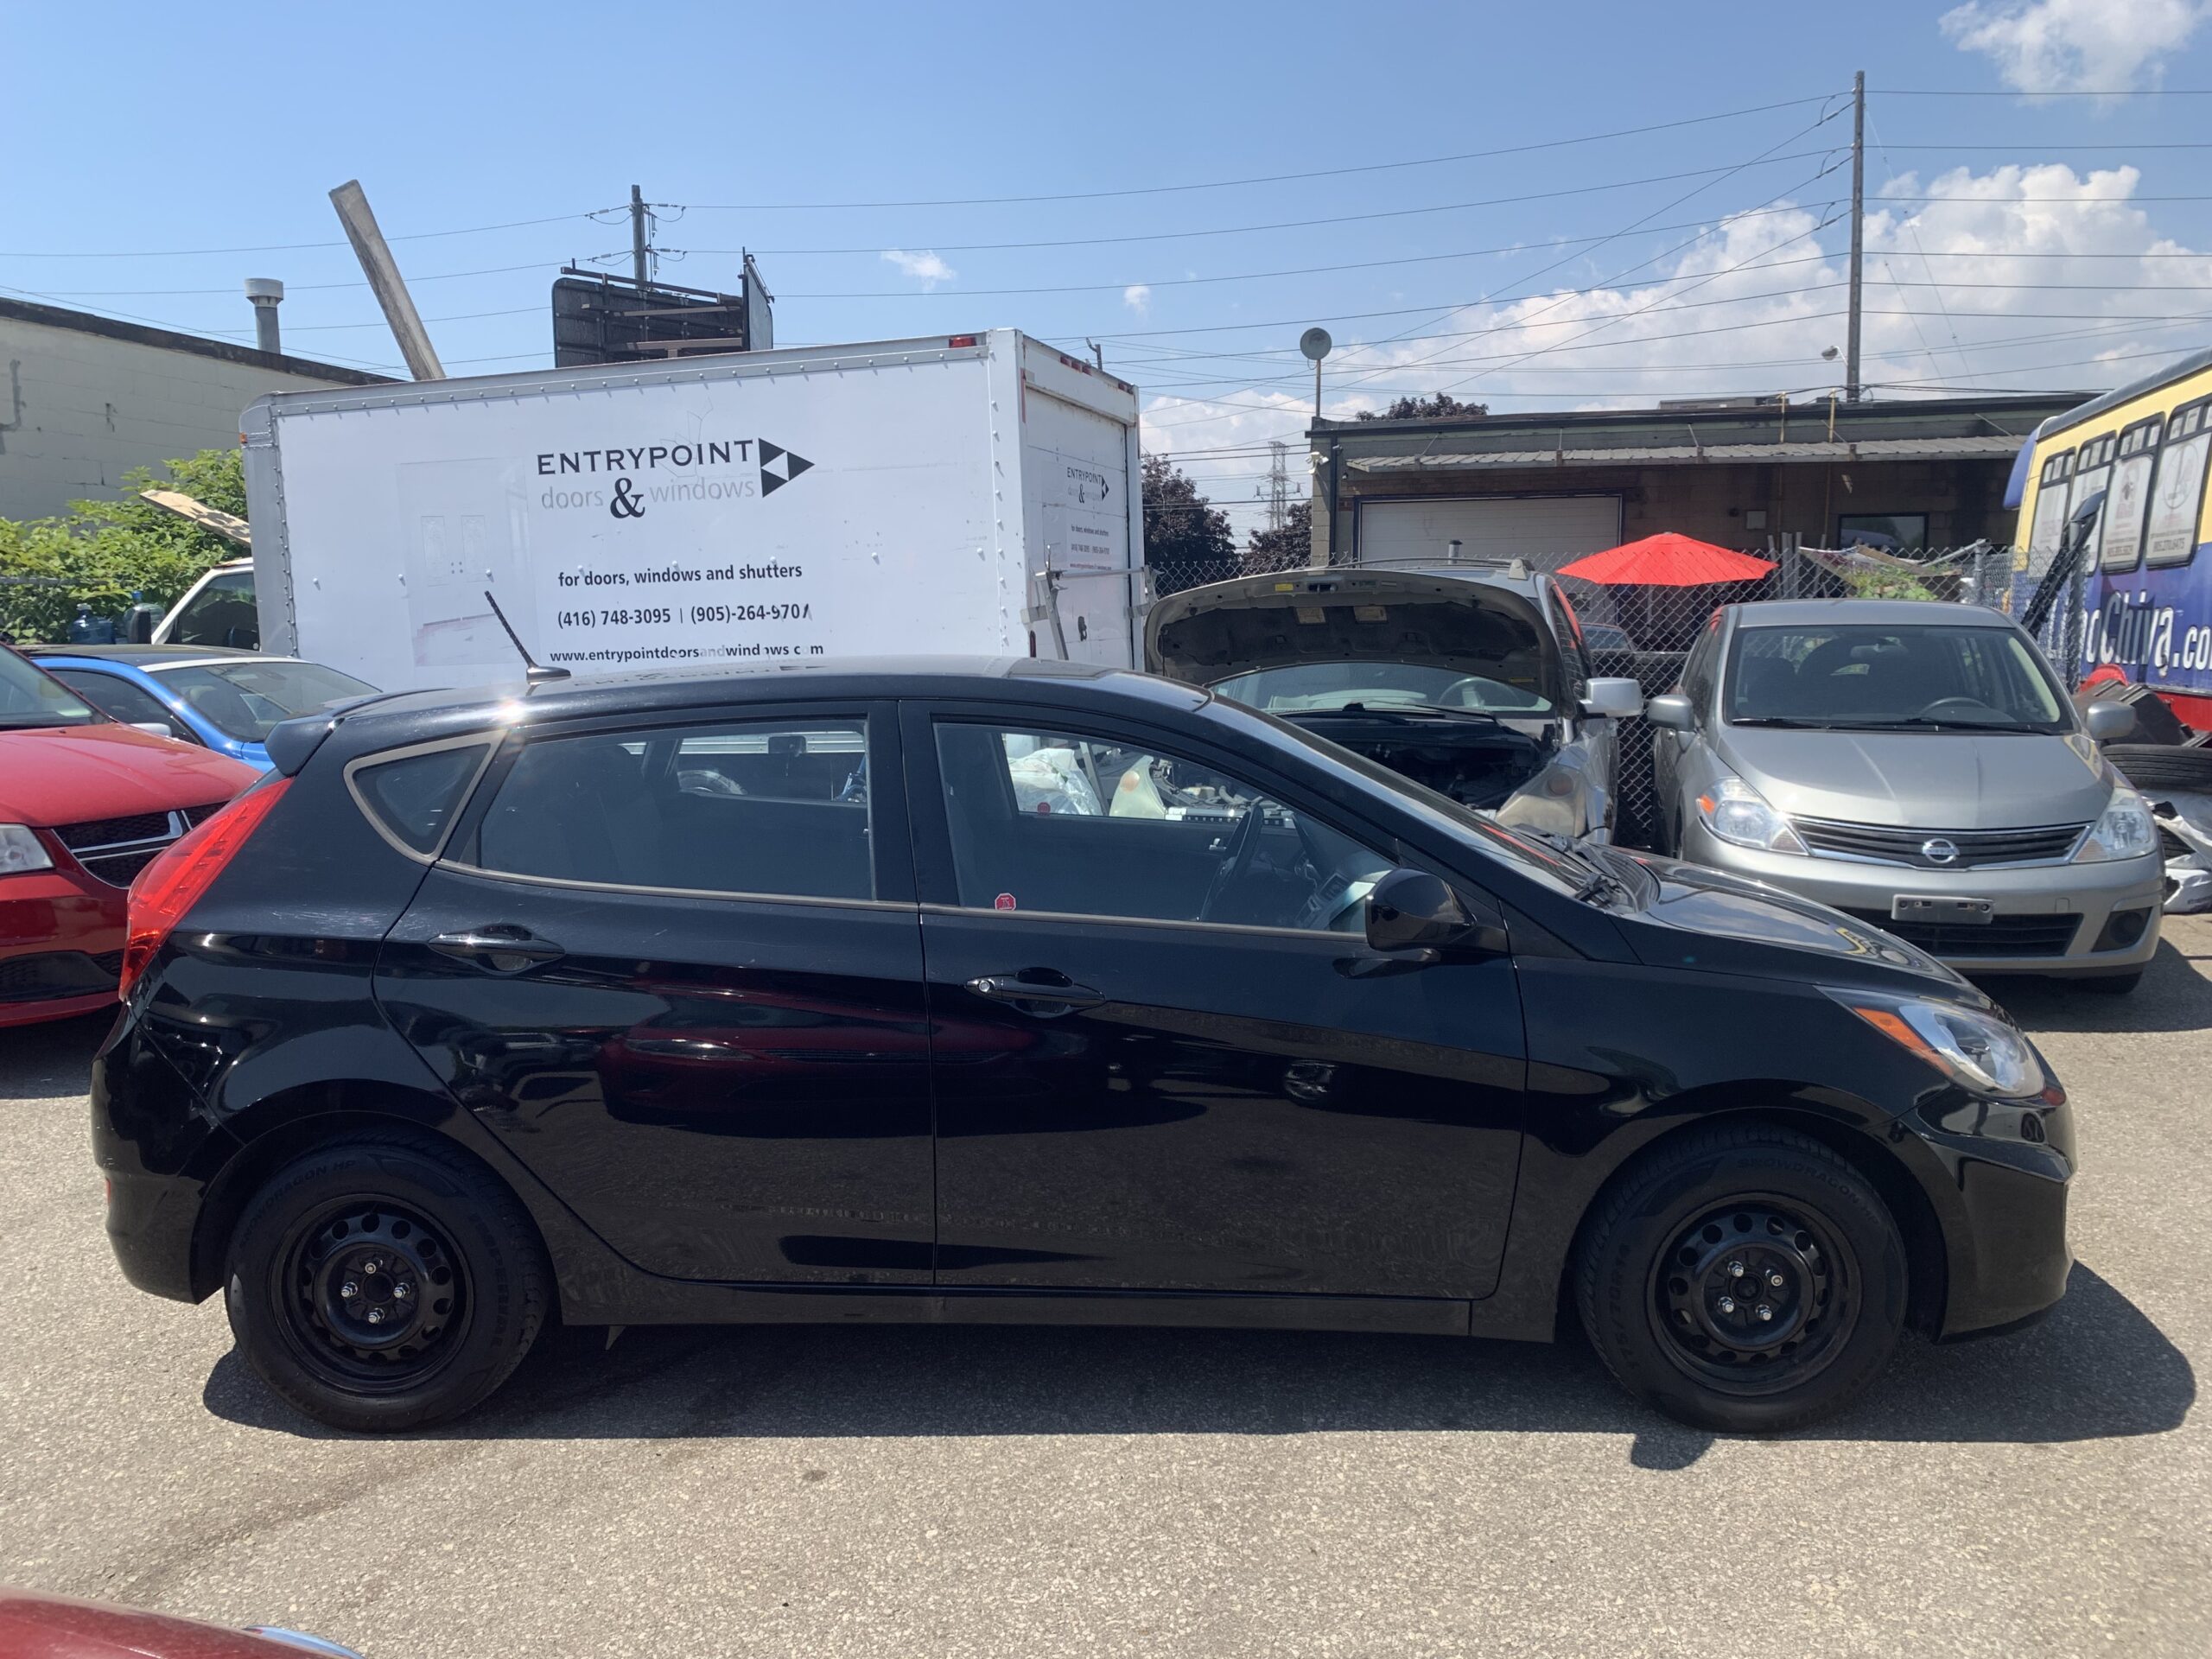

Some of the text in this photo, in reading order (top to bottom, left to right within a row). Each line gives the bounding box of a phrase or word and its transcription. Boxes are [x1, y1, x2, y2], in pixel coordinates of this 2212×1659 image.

[537, 439, 753, 475] ENTRYPOINT
[1067, 467, 1102, 485] ENTRYPOINT
[542, 477, 754, 518] doors & windows
[558, 563, 803, 587] for doors, windows and shutters
[558, 610, 596, 629] (416)
[601, 608, 671, 626] 748-3095
